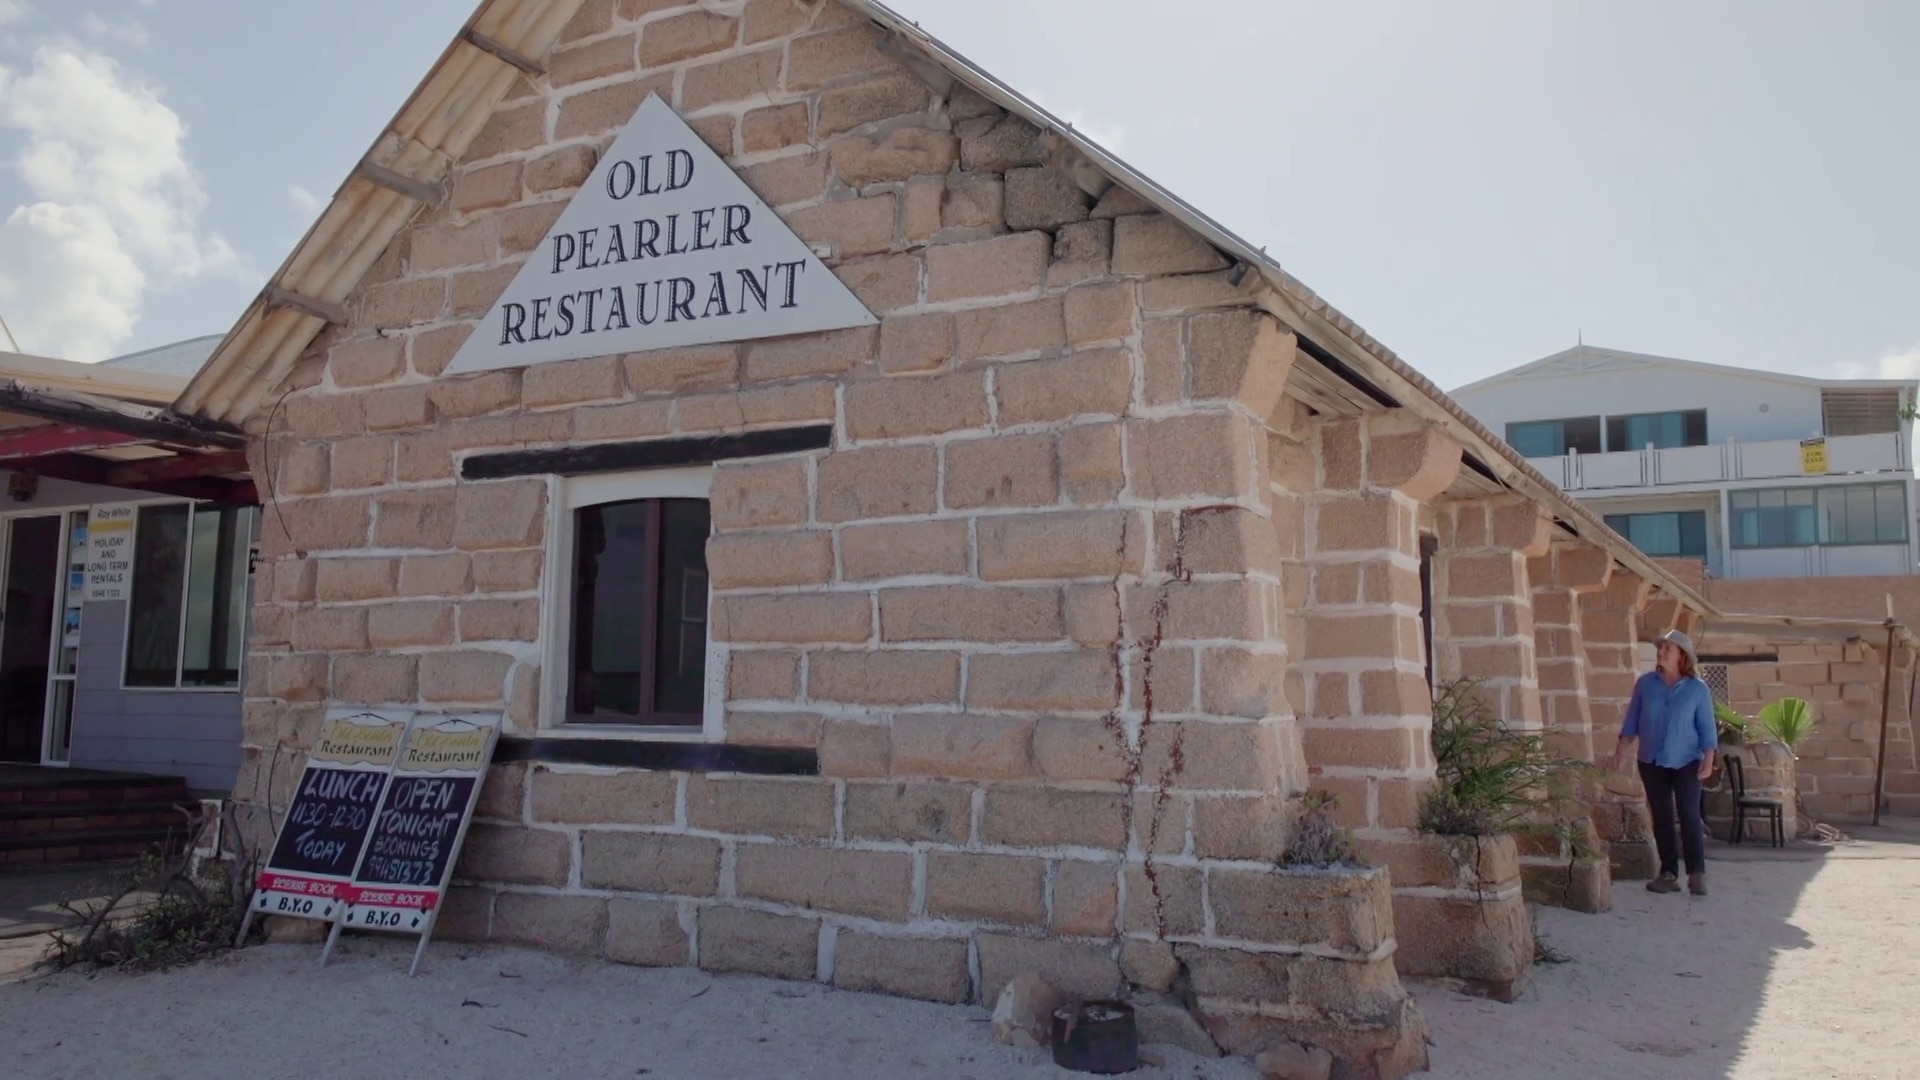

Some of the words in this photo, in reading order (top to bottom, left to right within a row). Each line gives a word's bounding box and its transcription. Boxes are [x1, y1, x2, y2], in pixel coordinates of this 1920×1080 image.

[606, 149, 695, 201] OLD
[551, 204, 753, 274] PEARLER
[499, 259, 806, 346] RESTAURANT
[97, 508, 111, 520] Ray
[94, 536, 125, 548] HOLIDAY
[101, 549, 116, 559] AND
[87, 562, 107, 572] LONG
[109, 560, 129, 571] TERM
[91, 573, 123, 585] RENTALS
[321, 740, 393, 757] Restaurant
[408, 749, 481, 763] Restaurant
[303, 768, 382, 803] LUNCH
[394, 779, 456, 811] OPEN
[380, 809, 459, 838] TONIGHT
[374, 836, 440, 860] BOOKINGS
[308, 882, 338, 895] BOOK
[278, 897, 313, 914] B.Y.O
[395, 892, 425, 906] BOOK
[365, 910, 400, 927] B.Y.O
